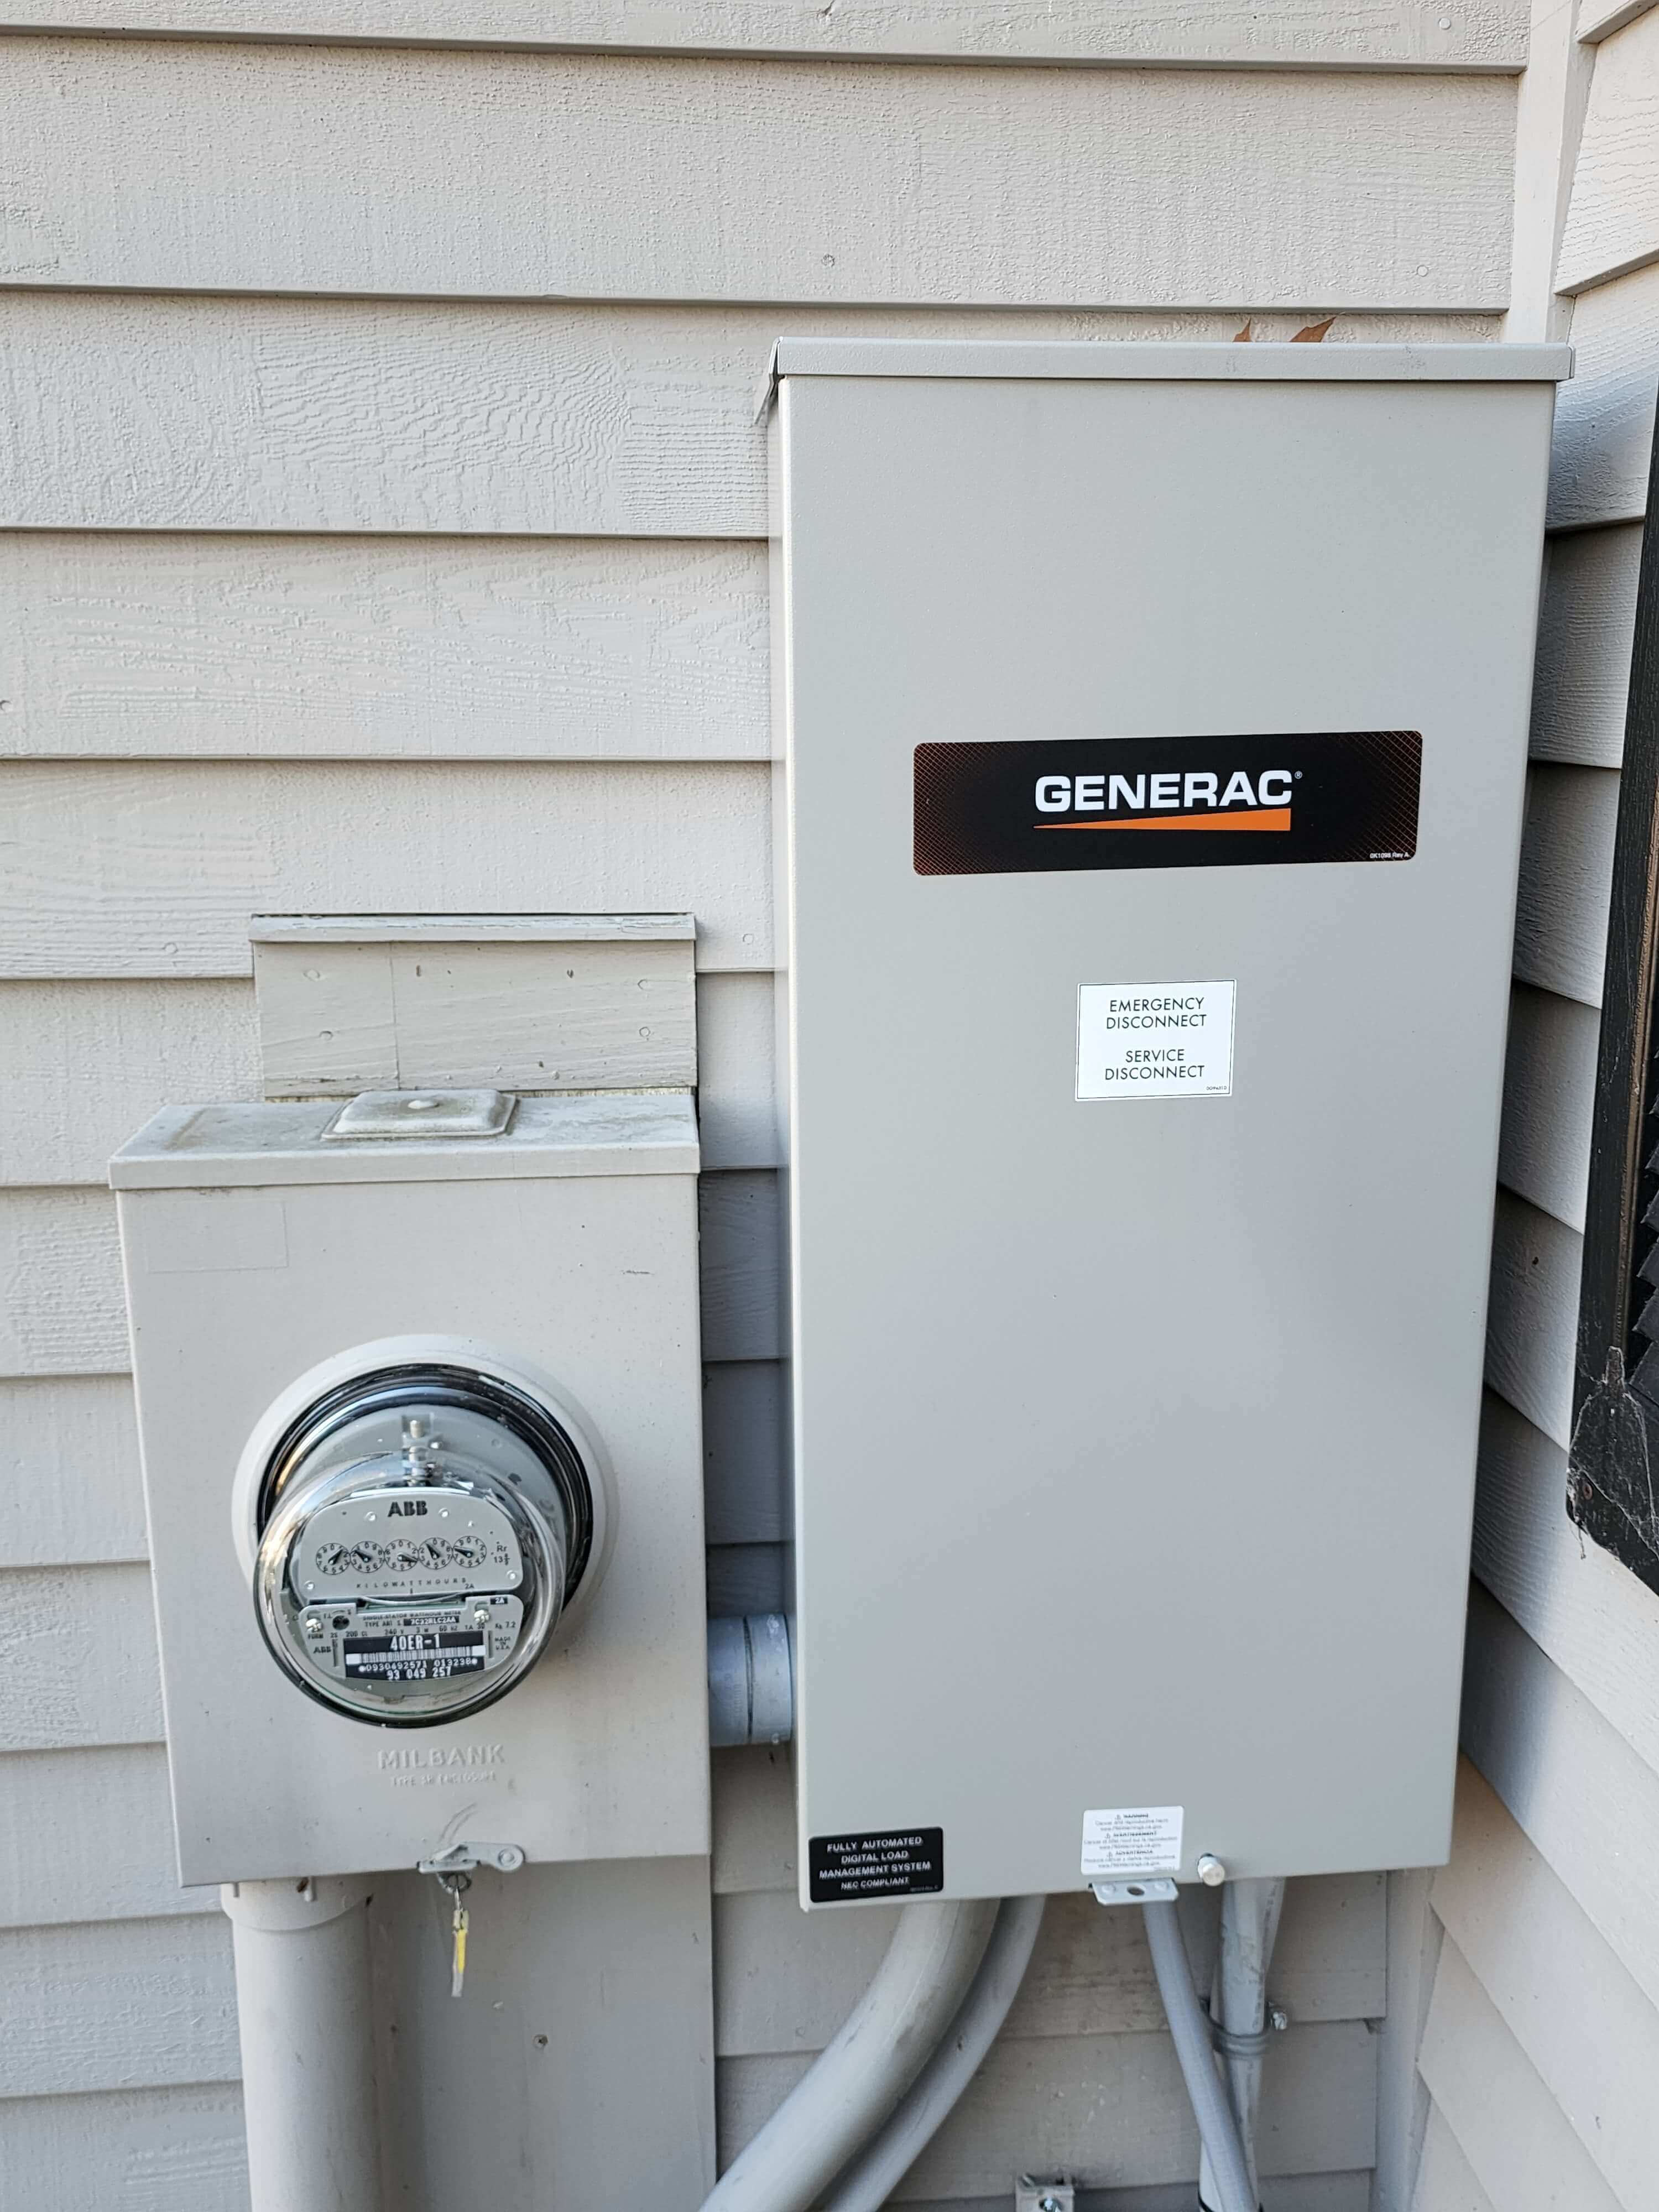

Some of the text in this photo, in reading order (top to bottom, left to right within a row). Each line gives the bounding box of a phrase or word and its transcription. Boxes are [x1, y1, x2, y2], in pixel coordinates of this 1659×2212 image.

[1035, 770, 1292, 812] GENERAC
[1110, 997, 1204, 1012] EMERGENCY
[1107, 1014, 1207, 1029] DISCONNECT
[1125, 1048, 1185, 1063] SERVICE
[1105, 1065, 1205, 1080] DISCONNECT
[388, 1500, 427, 1517] ABB
[387, 1670, 400, 1680] 93
[377, 1743, 505, 1770] MILBANK
[827, 1836, 923, 1853] FULLY AUTOMATED
[841, 1850, 909, 1865] DIGITAL LOAD
[819, 1861, 931, 1880] MANAGEMENT SYSTEM
[841, 1880, 859, 1890] NEC
[860, 1876, 910, 1888] COMPLIANT
